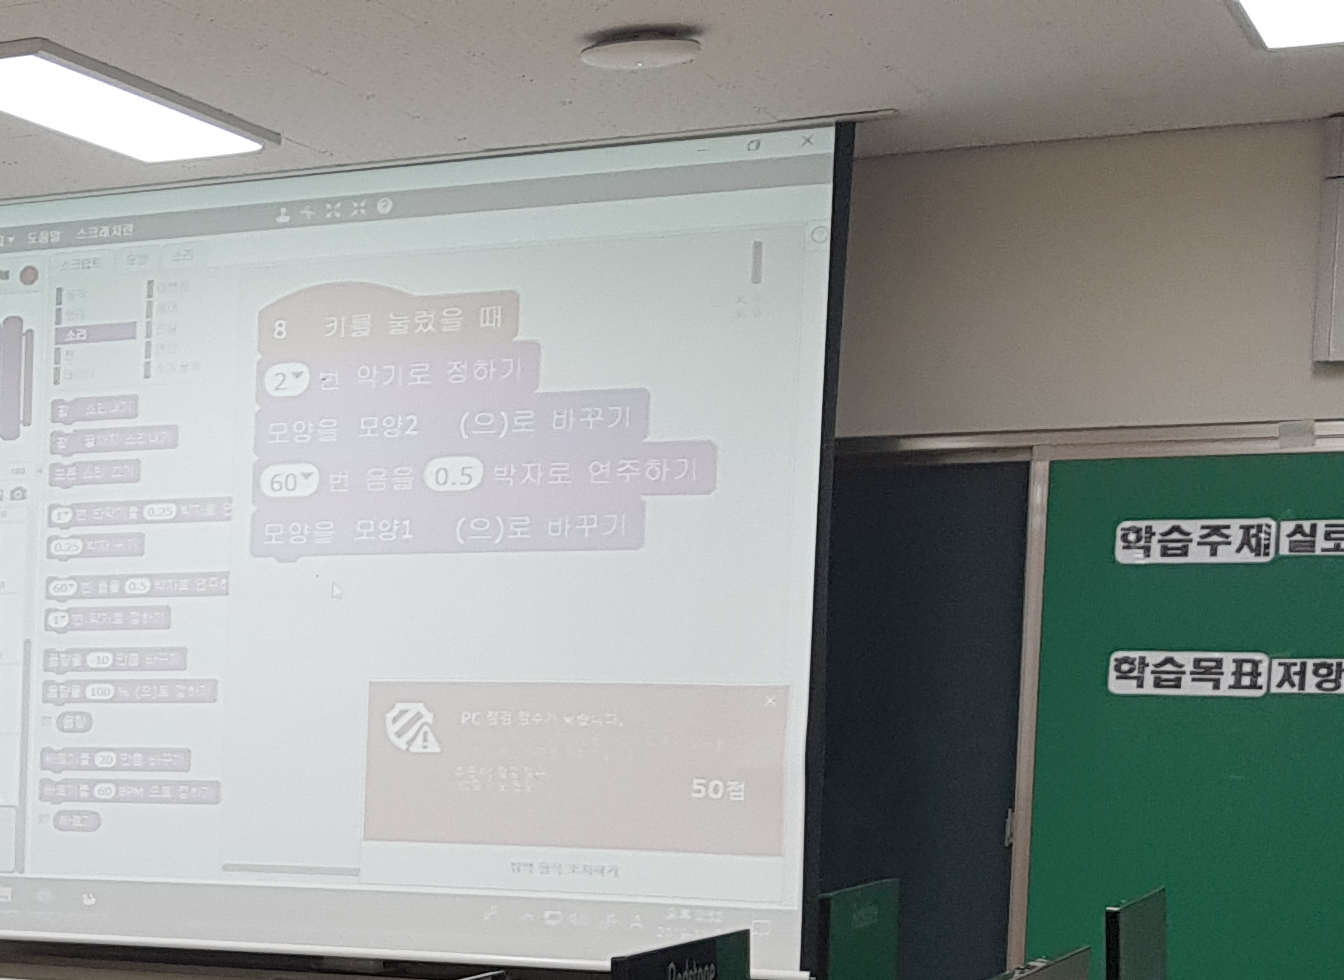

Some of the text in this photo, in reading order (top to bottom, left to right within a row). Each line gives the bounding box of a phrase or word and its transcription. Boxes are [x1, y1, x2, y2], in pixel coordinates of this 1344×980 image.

[273, 304, 503, 339] 8 키를 눌렀을 때
[64, 328, 87, 341] 소리
[273, 357, 522, 391] 2 번 악기로 정하기
[267, 405, 630, 445] 모양을 모양2 (으)로 바꾸기
[269, 458, 697, 493] 60 번 음을 0.5 박자로 연주하기
[147, 506, 173, 517] 0.25
[263, 514, 627, 545] 모양을 모양1 (으)로 바꾸기
[1120, 522, 1344, 558] 학습주제 실로
[54, 542, 80, 553] 0.25
[52, 583, 68, 593] 60
[128, 581, 147, 592] 0.5
[1113, 655, 1344, 692] 학습목표 저항
[90, 686, 111, 697] 100
[460, 710, 482, 726] PC
[117, 786, 144, 798] BPM
[690, 778, 747, 803] 50점
